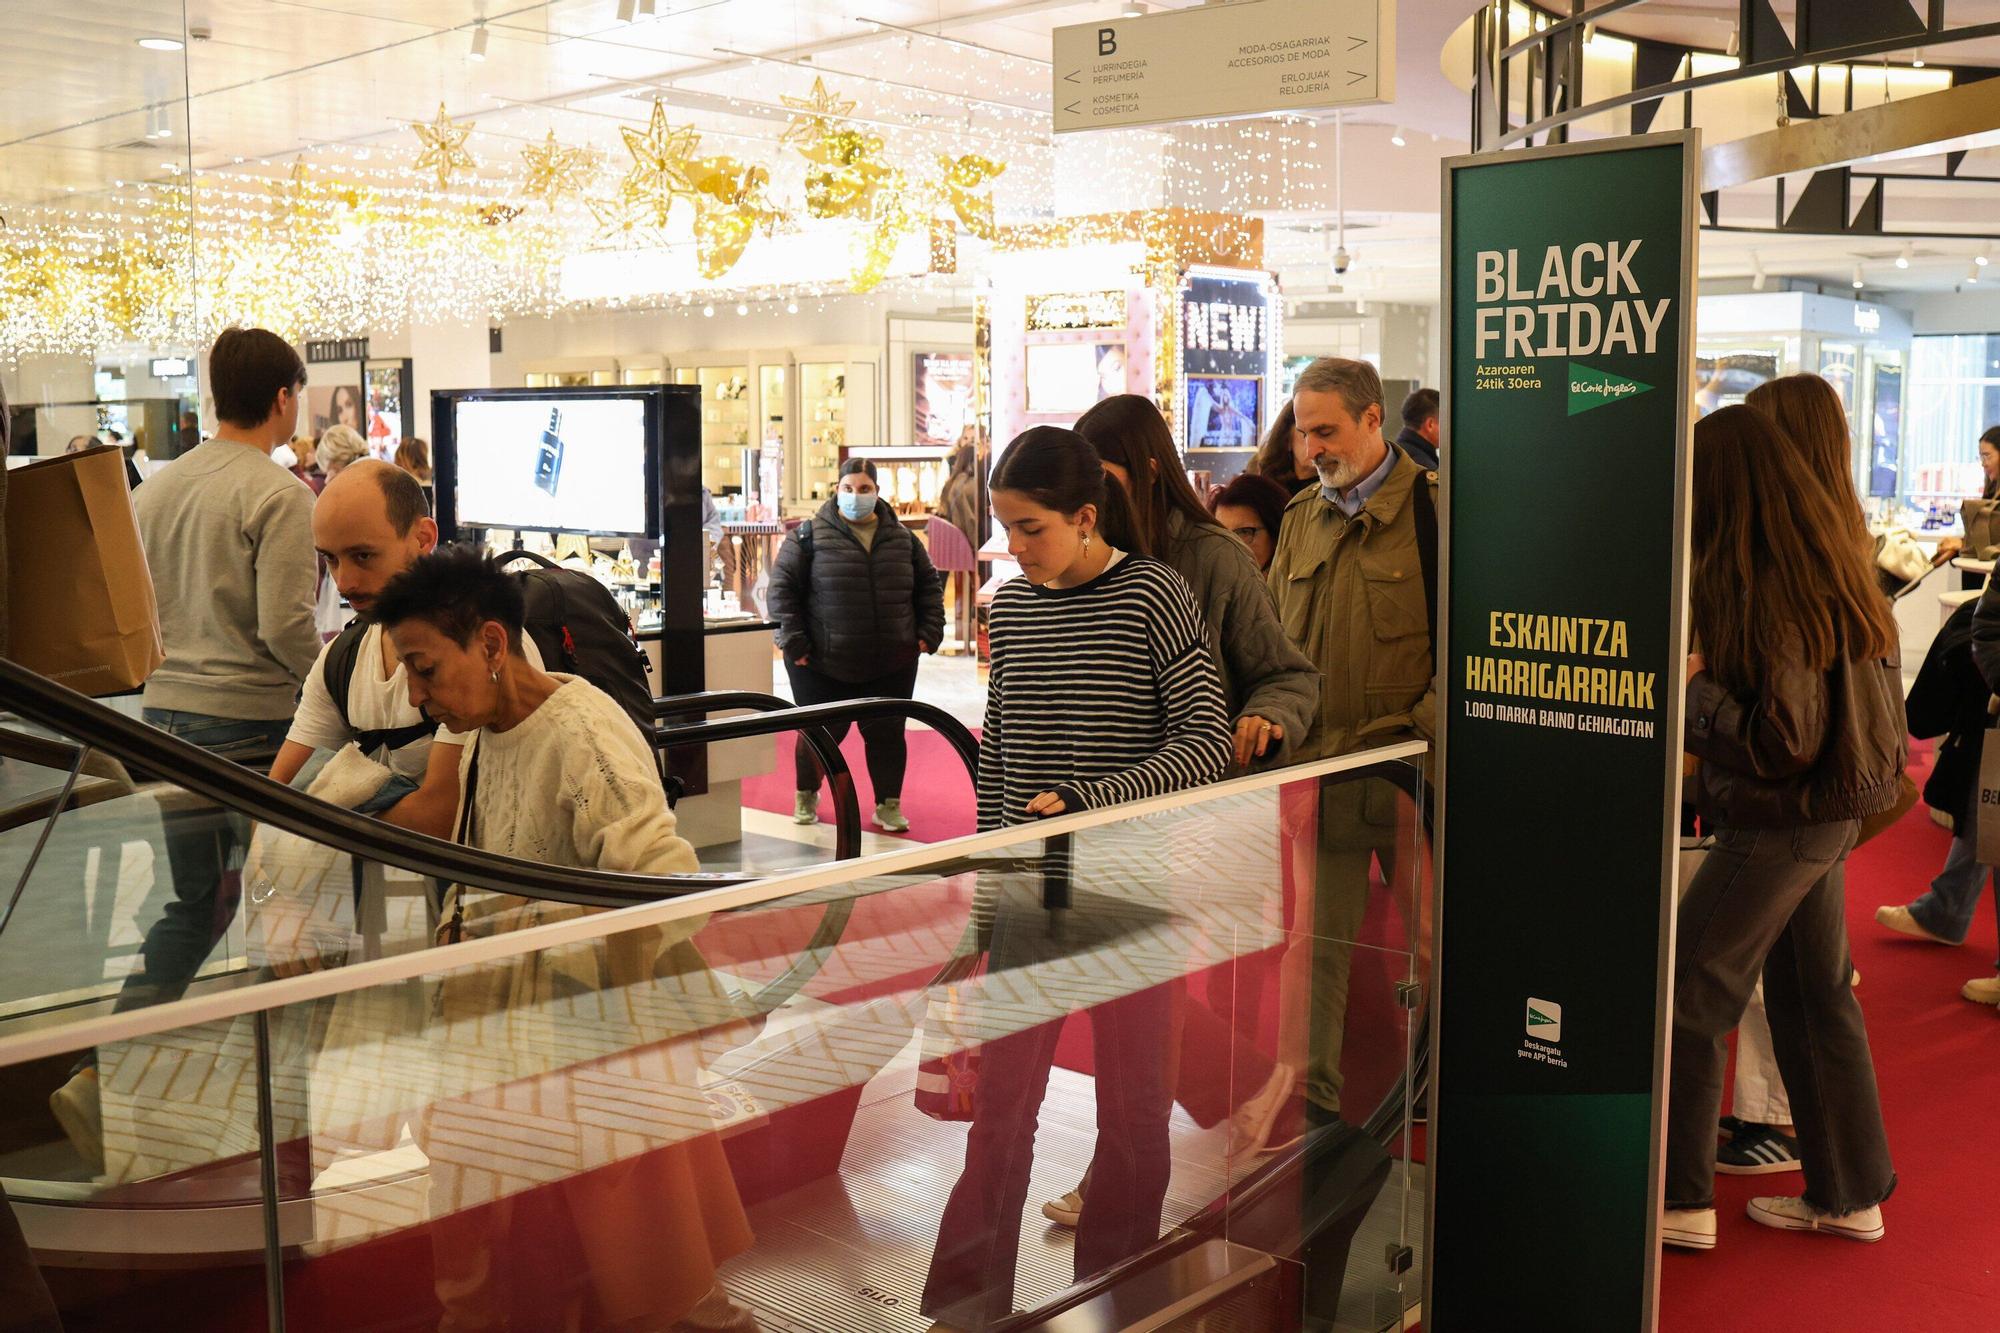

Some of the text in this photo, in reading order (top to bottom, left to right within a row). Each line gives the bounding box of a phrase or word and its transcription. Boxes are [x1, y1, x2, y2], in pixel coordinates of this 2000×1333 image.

[1098, 27, 1118, 56] B
[1239, 36, 1331, 55] MODA-OSAGARRIAK
[1093, 60, 1148, 73] LURRINDEGIA
[1228, 49, 1331, 68] ACCESORIOS DE MODA
[1281, 70, 1330, 83] ERLOJUAK
[1093, 92, 1139, 104] KOSMETIKA
[1476, 239, 1643, 303] BLACK
[1186, 301, 1267, 352] NEW!
[1475, 298, 1672, 359] FRIDAY
[1476, 364, 1535, 376] Azaroaren
[1476, 377, 1542, 390] 24tik 30era
[1571, 378, 1637, 397] El Corte Inglés
[1490, 611, 1628, 658] ESKAINTZA
[1466, 655, 1656, 710] HARRIGARRIAK
[1465, 701, 1654, 739] 1.000 MARKA BAINO GEHIAGOTAN
[1524, 1039, 1561, 1056] Deskargatu
[1517, 1049, 1568, 1068] gure APP berria
[858, 1287, 899, 1306] OTIS
